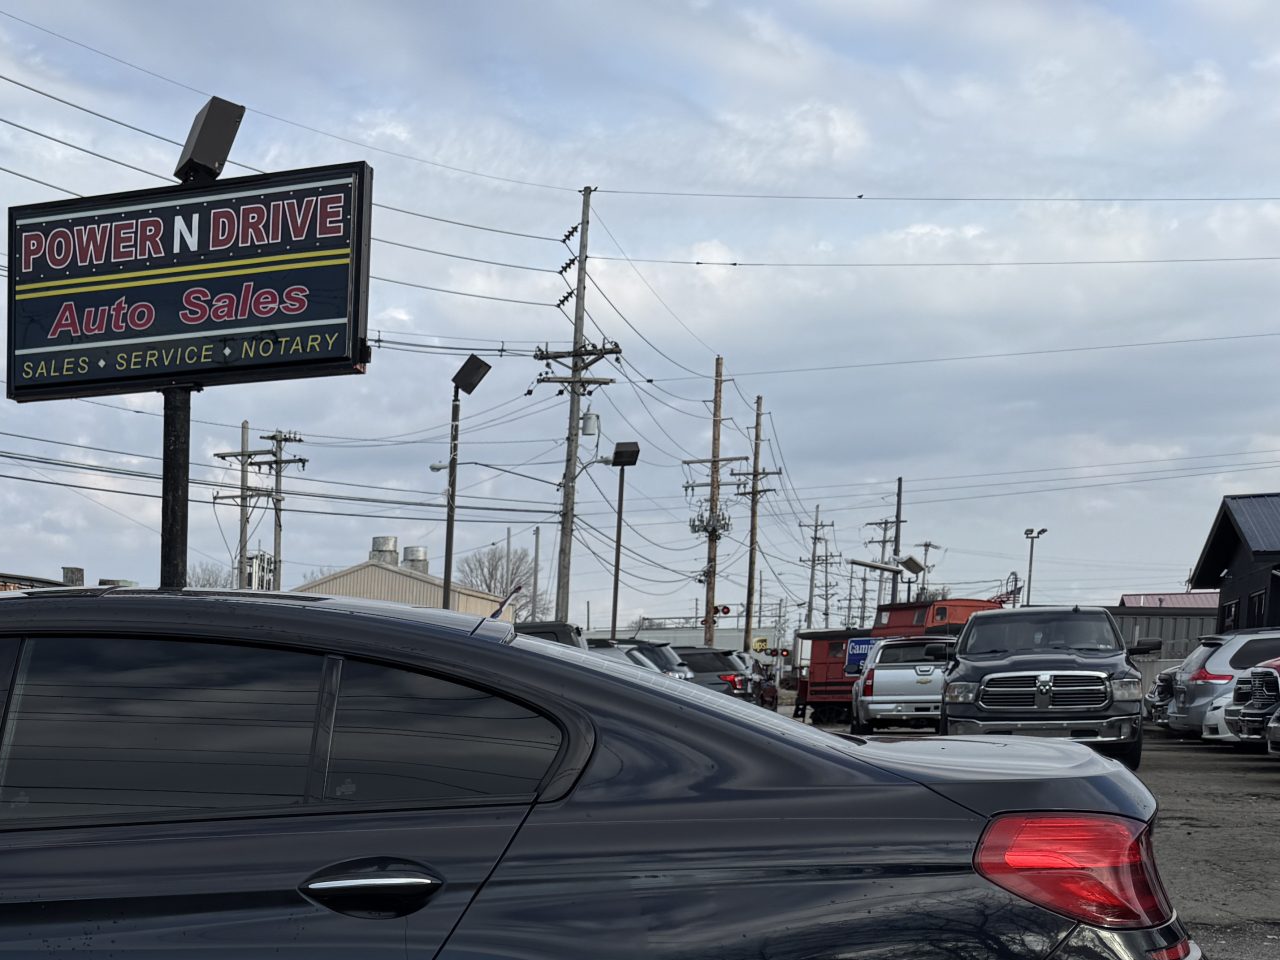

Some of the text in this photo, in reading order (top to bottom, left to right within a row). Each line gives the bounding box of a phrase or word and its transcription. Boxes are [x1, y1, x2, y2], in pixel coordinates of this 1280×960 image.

[22, 193, 344, 272] POWER N DRIVE
[48, 282, 309, 338] Auto Sales
[22, 332, 339, 379] SALES SERVICE NOTARY
